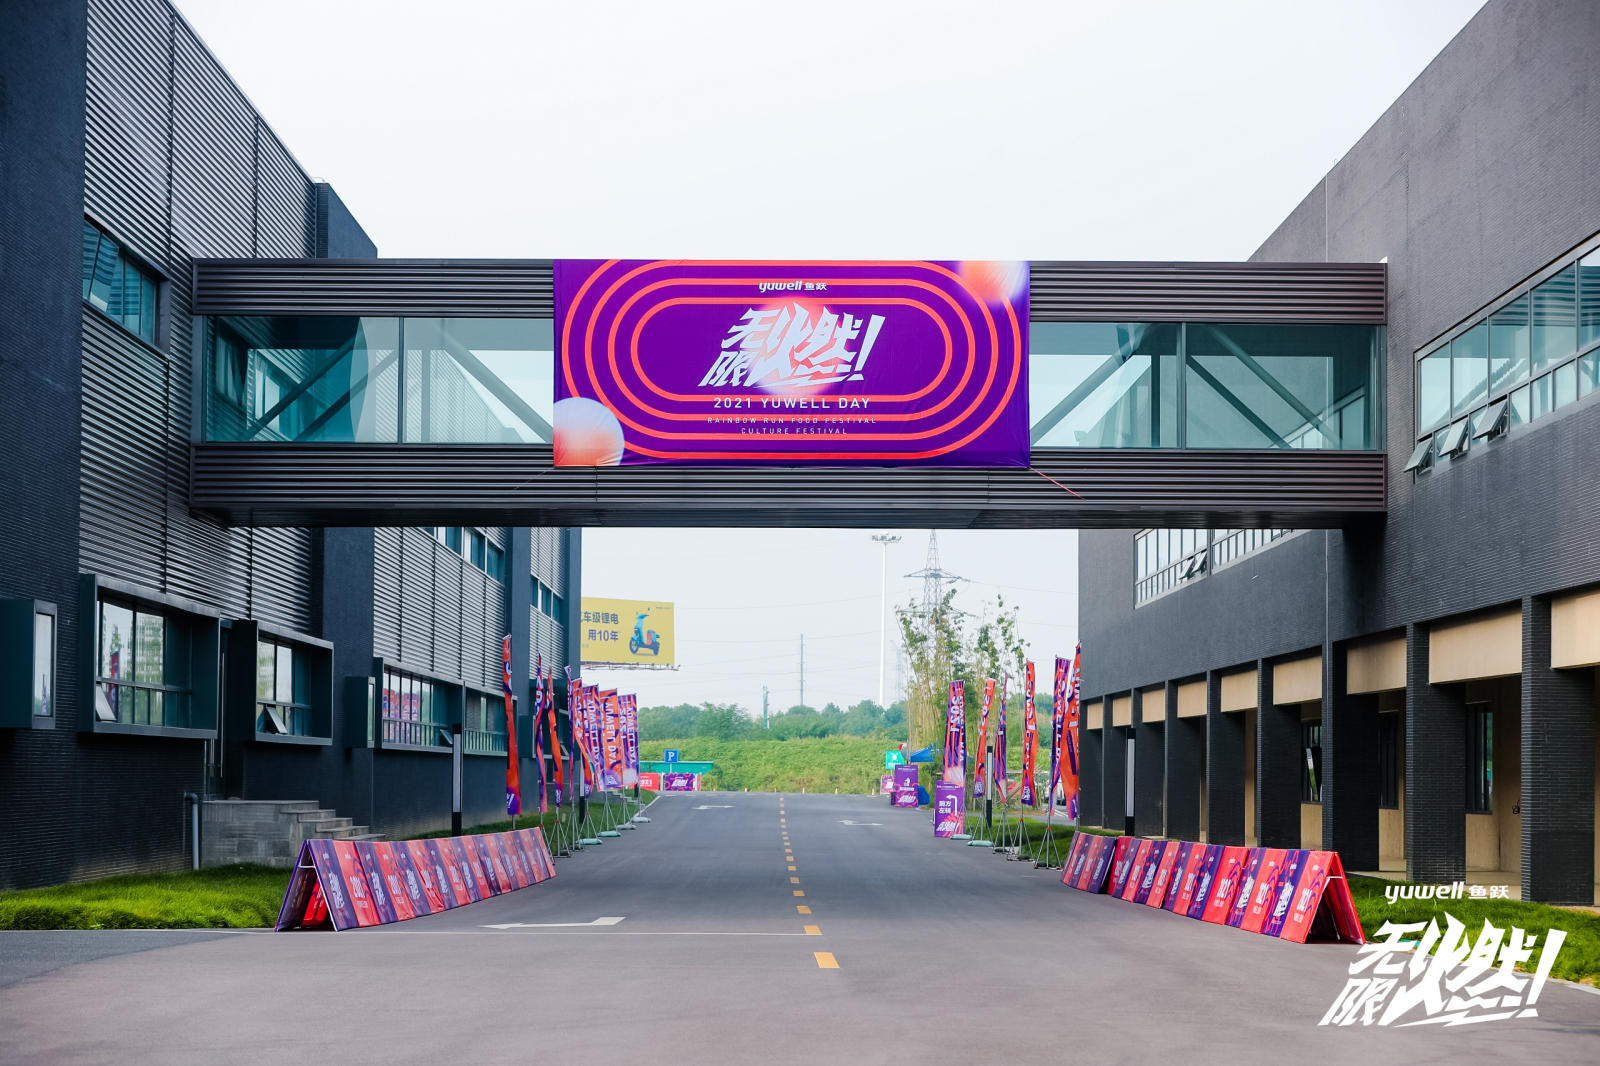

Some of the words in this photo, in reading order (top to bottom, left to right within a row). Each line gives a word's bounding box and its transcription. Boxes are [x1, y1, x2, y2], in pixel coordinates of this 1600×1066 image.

[758, 280, 803, 293] yuwell
[803, 282, 828, 291] 鱼跃
[713, 397, 751, 409] 2021
[760, 397, 831, 409] YUWELL
[838, 397, 870, 409] DAY
[581, 611, 619, 625] 车级锂电
[588, 629, 619, 642] 用10年
[668, 751, 675, 762] P
